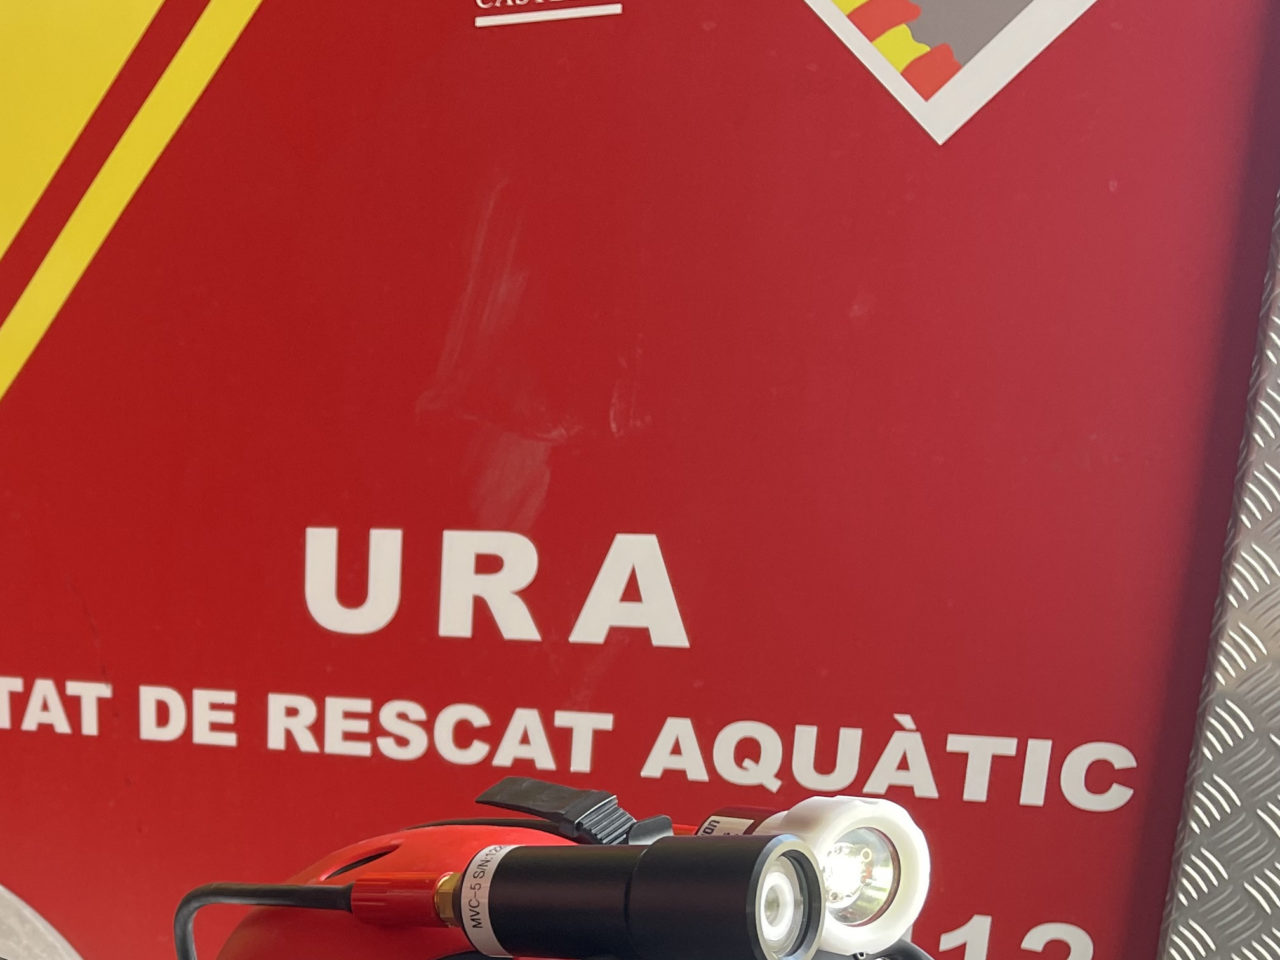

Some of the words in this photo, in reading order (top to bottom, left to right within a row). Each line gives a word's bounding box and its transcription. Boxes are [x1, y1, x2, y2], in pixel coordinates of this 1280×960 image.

[305, 528, 690, 648] URA
[139, 685, 237, 747] DE
[267, 693, 614, 773] RESCAT
[640, 713, 1137, 812] AQUÀTIC
